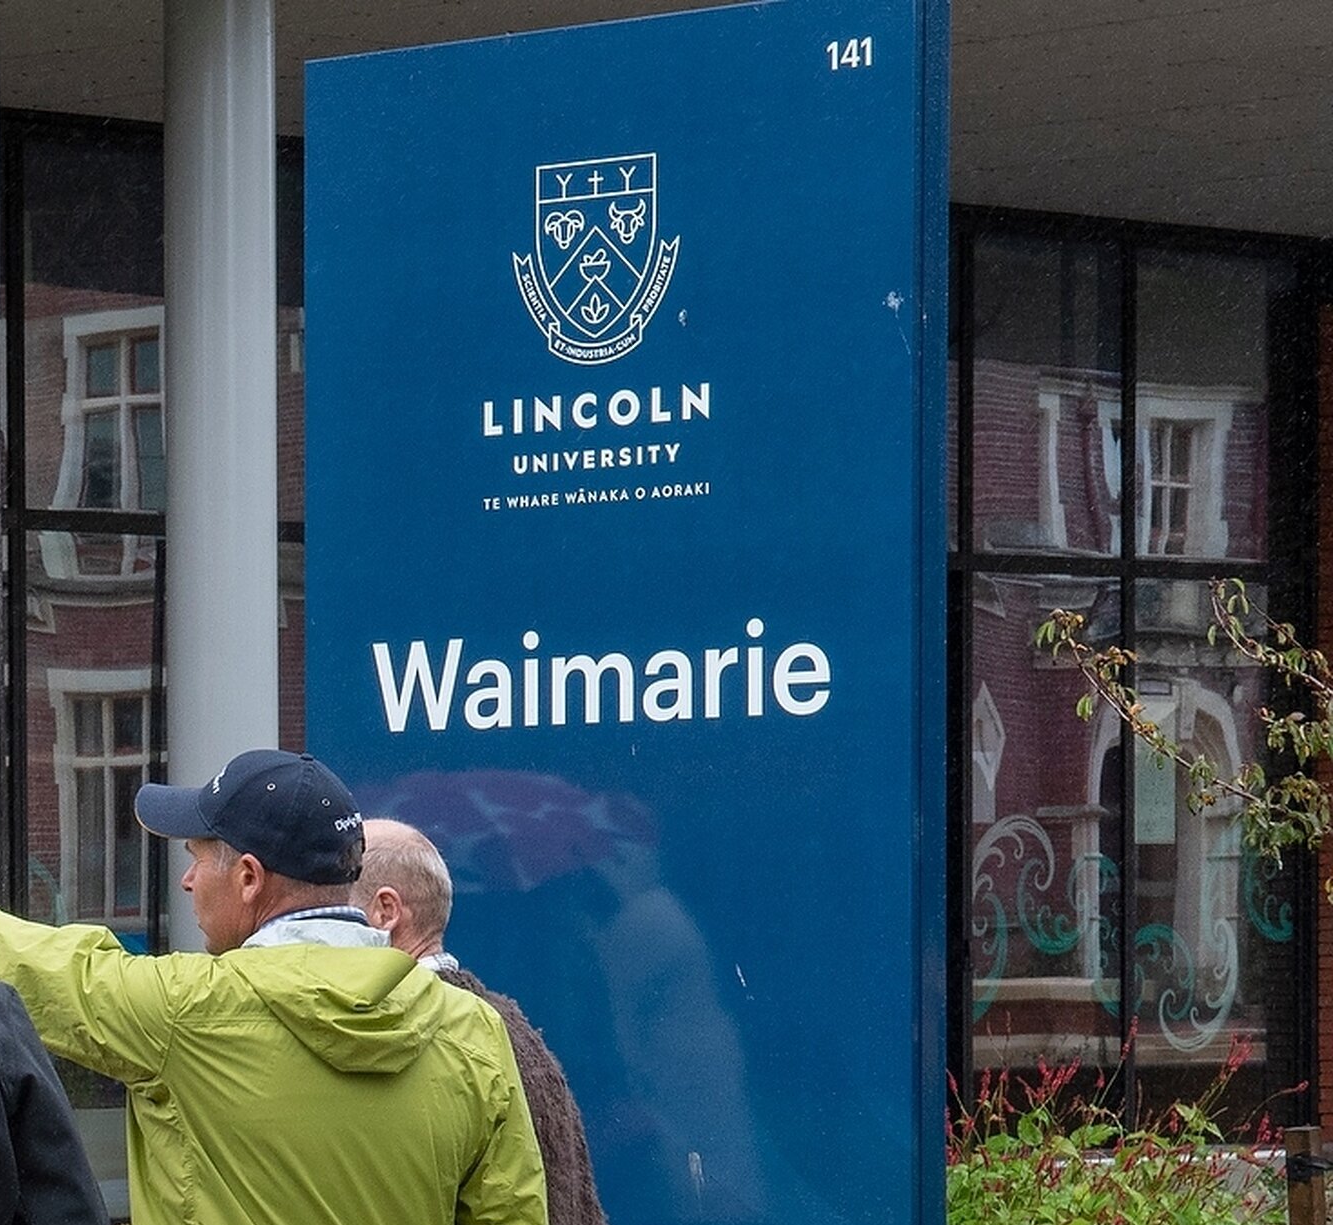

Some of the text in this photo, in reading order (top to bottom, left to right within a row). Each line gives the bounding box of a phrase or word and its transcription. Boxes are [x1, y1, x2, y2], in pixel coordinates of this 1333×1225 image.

[826, 36, 873, 70] 141
[483, 383, 710, 436] LINCOLN
[513, 443, 680, 475] UNIVERSITY
[483, 498, 501, 511] TE
[506, 493, 559, 509] WHARE
[635, 488, 646, 500] O
[651, 482, 710, 499] AORAKI
[372, 617, 831, 733] Waimarie
